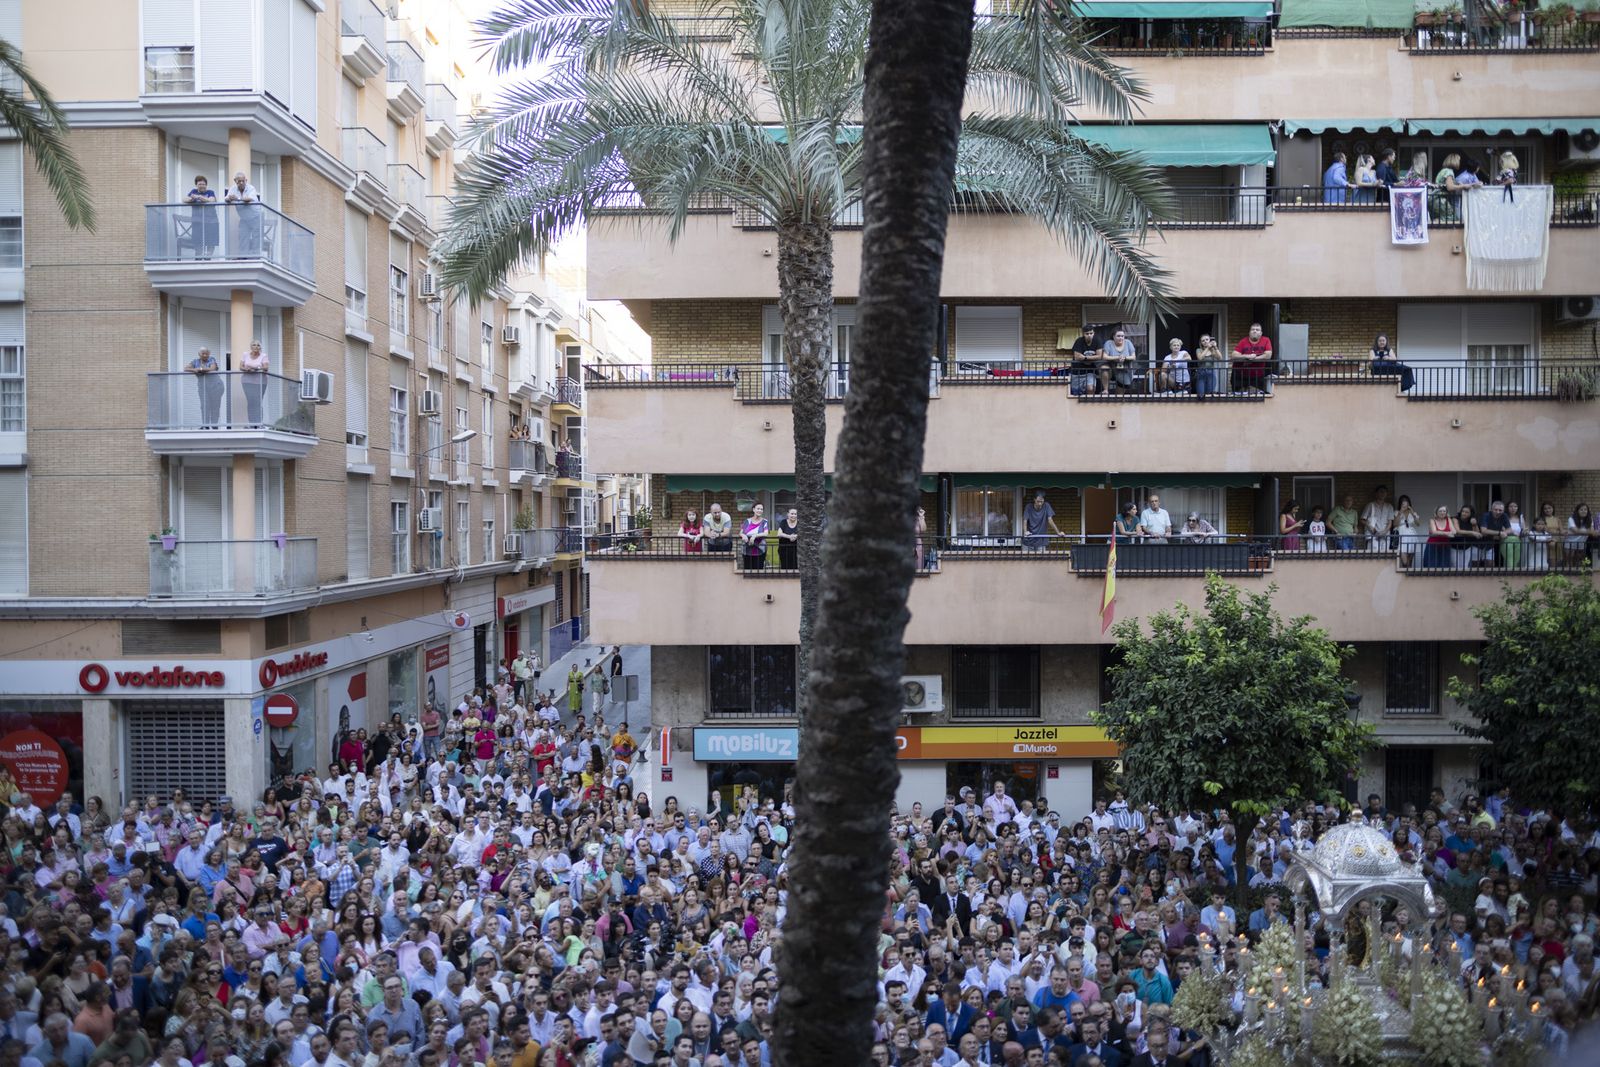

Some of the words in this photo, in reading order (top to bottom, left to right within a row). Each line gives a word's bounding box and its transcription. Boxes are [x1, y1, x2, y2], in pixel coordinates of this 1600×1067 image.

[114, 665, 225, 688] vodafone
[1014, 728, 1057, 739] Jazztel
[16, 744, 32, 752] NON
[1026, 744, 1057, 753] Mundo
